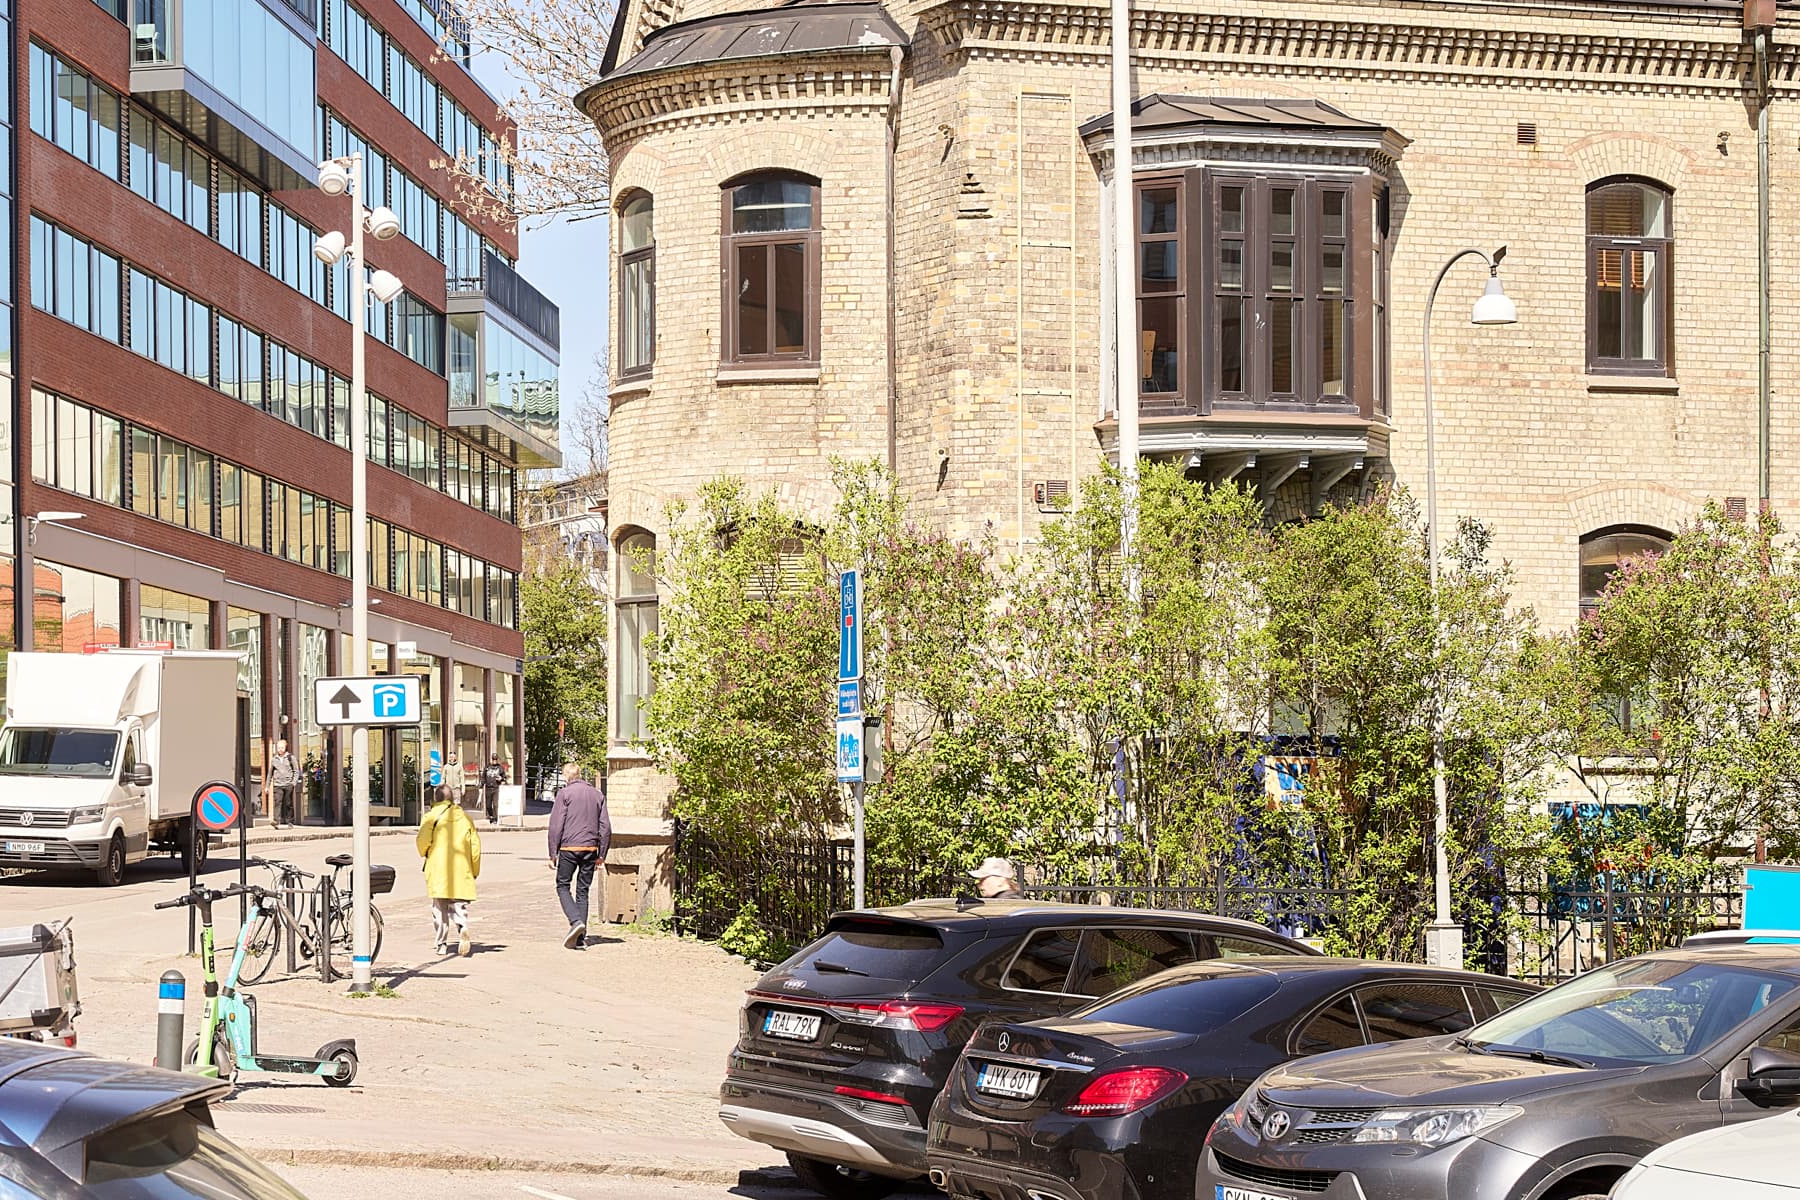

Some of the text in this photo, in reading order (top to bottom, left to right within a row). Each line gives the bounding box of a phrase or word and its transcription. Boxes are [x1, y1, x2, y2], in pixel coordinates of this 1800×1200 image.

[382, 693, 398, 717] P
[772, 1014, 815, 1035] RAL 79K
[987, 1067, 1036, 1091] JYK 60Y
